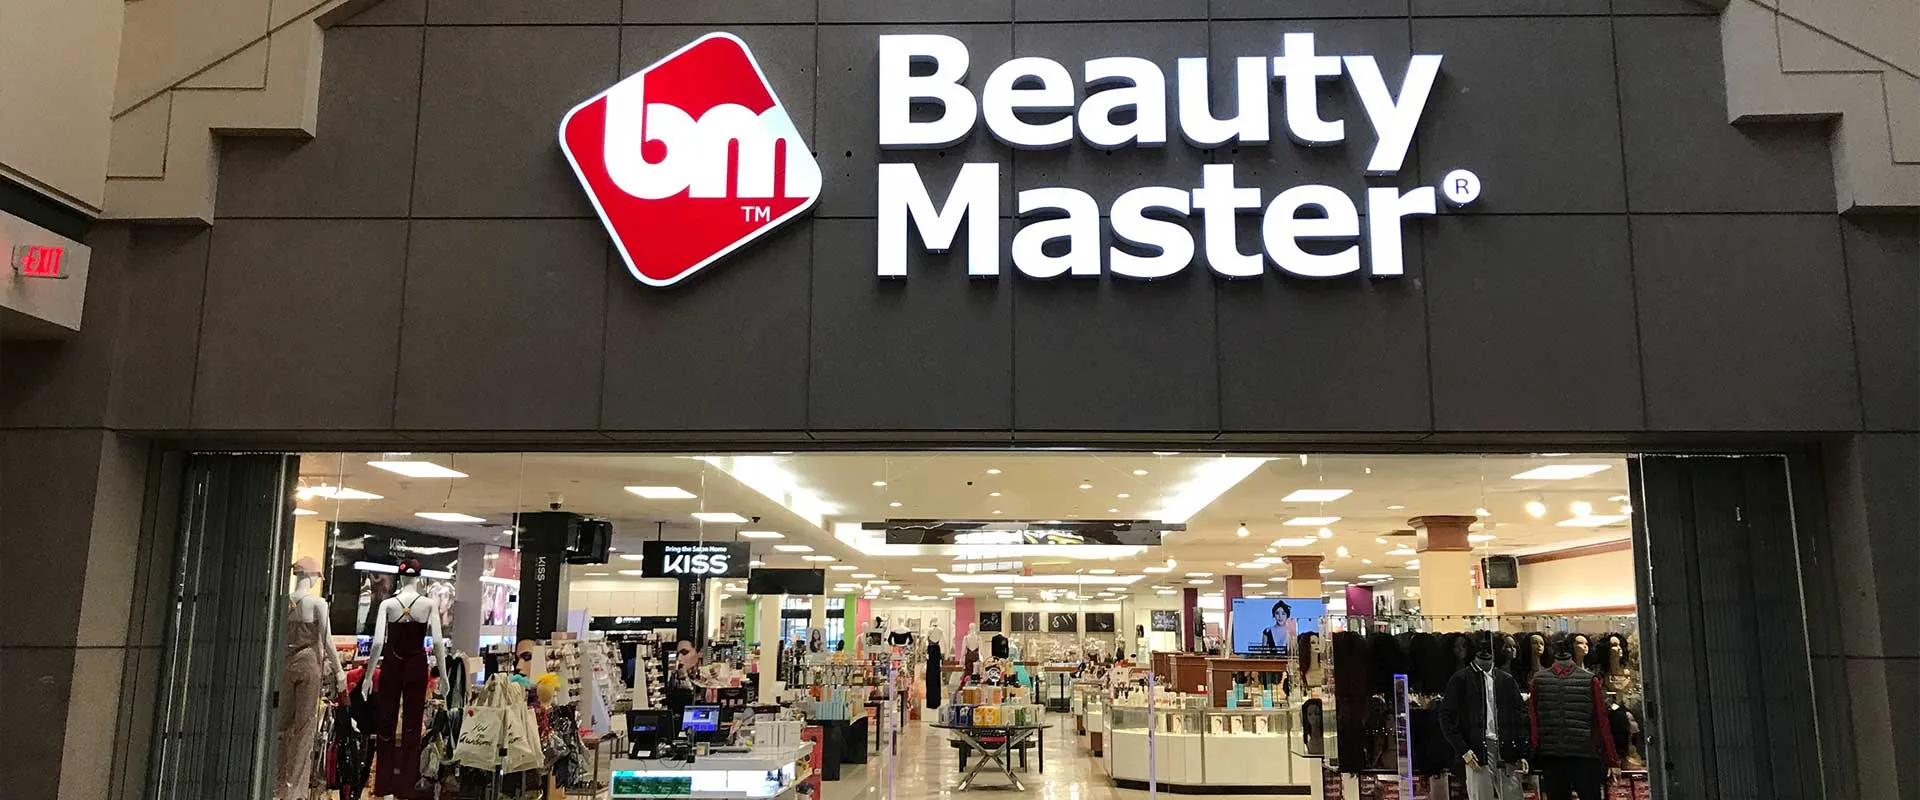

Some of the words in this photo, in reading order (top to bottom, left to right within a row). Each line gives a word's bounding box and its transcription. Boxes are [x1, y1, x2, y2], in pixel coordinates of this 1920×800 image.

[877, 32, 1444, 171] Beauty
[740, 205, 771, 222] TM
[877, 162, 1436, 279] Master
[24, 246, 64, 276] EXIT
[537, 556, 546, 581] KISS
[664, 554, 728, 574] KISS
